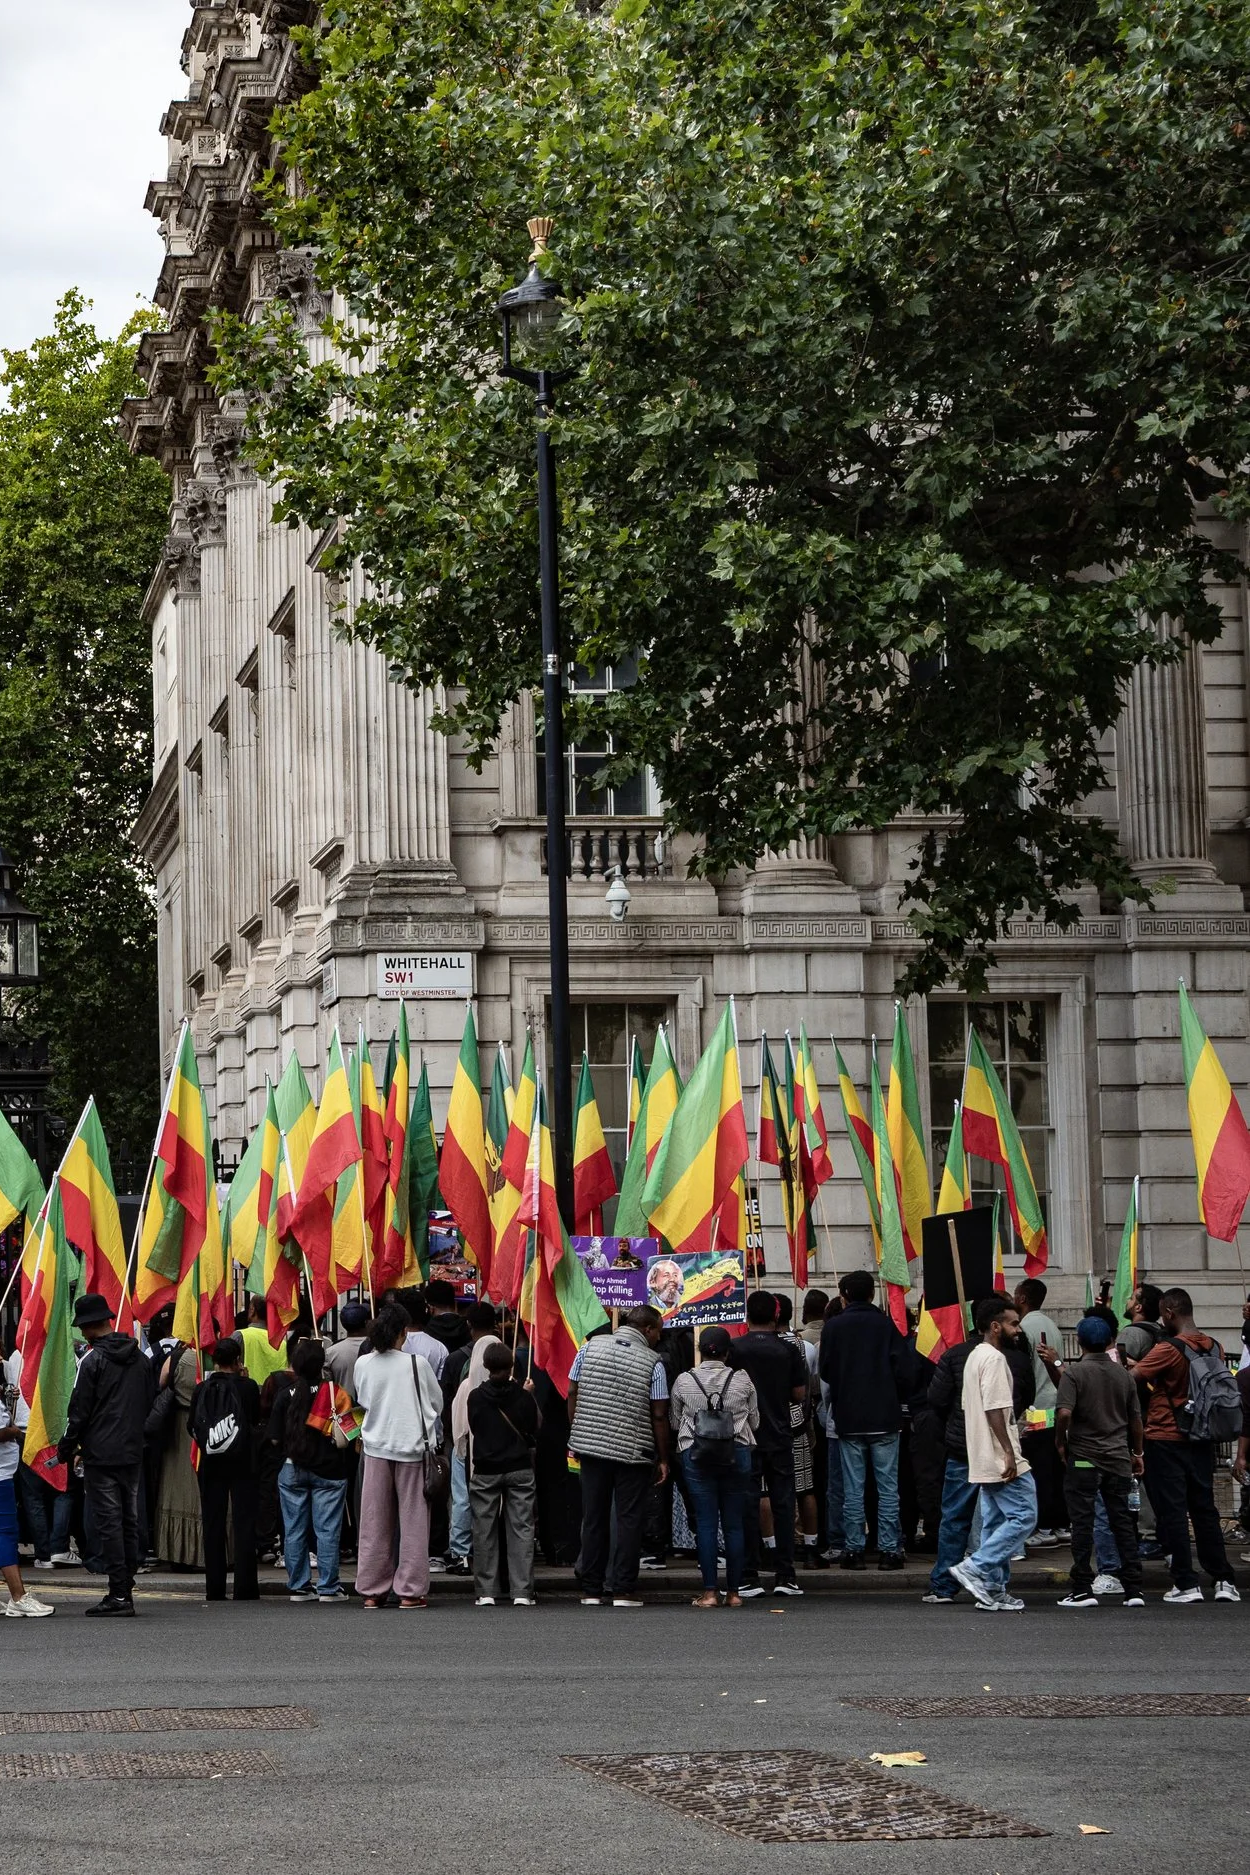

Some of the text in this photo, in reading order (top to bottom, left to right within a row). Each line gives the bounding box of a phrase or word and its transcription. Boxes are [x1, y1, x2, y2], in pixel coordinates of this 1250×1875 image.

[384, 957, 465, 969] WHITEHALL
[385, 972, 414, 984] SW1
[747, 1233, 762, 1248] ON
[592, 1277, 606, 1285] Abiy
[608, 1286, 633, 1296] Killing
[612, 1298, 644, 1307] Women
[671, 1317, 690, 1327] Free
[719, 1311, 745, 1321] Tantu
[209, 1413, 235, 1446] NIKE
